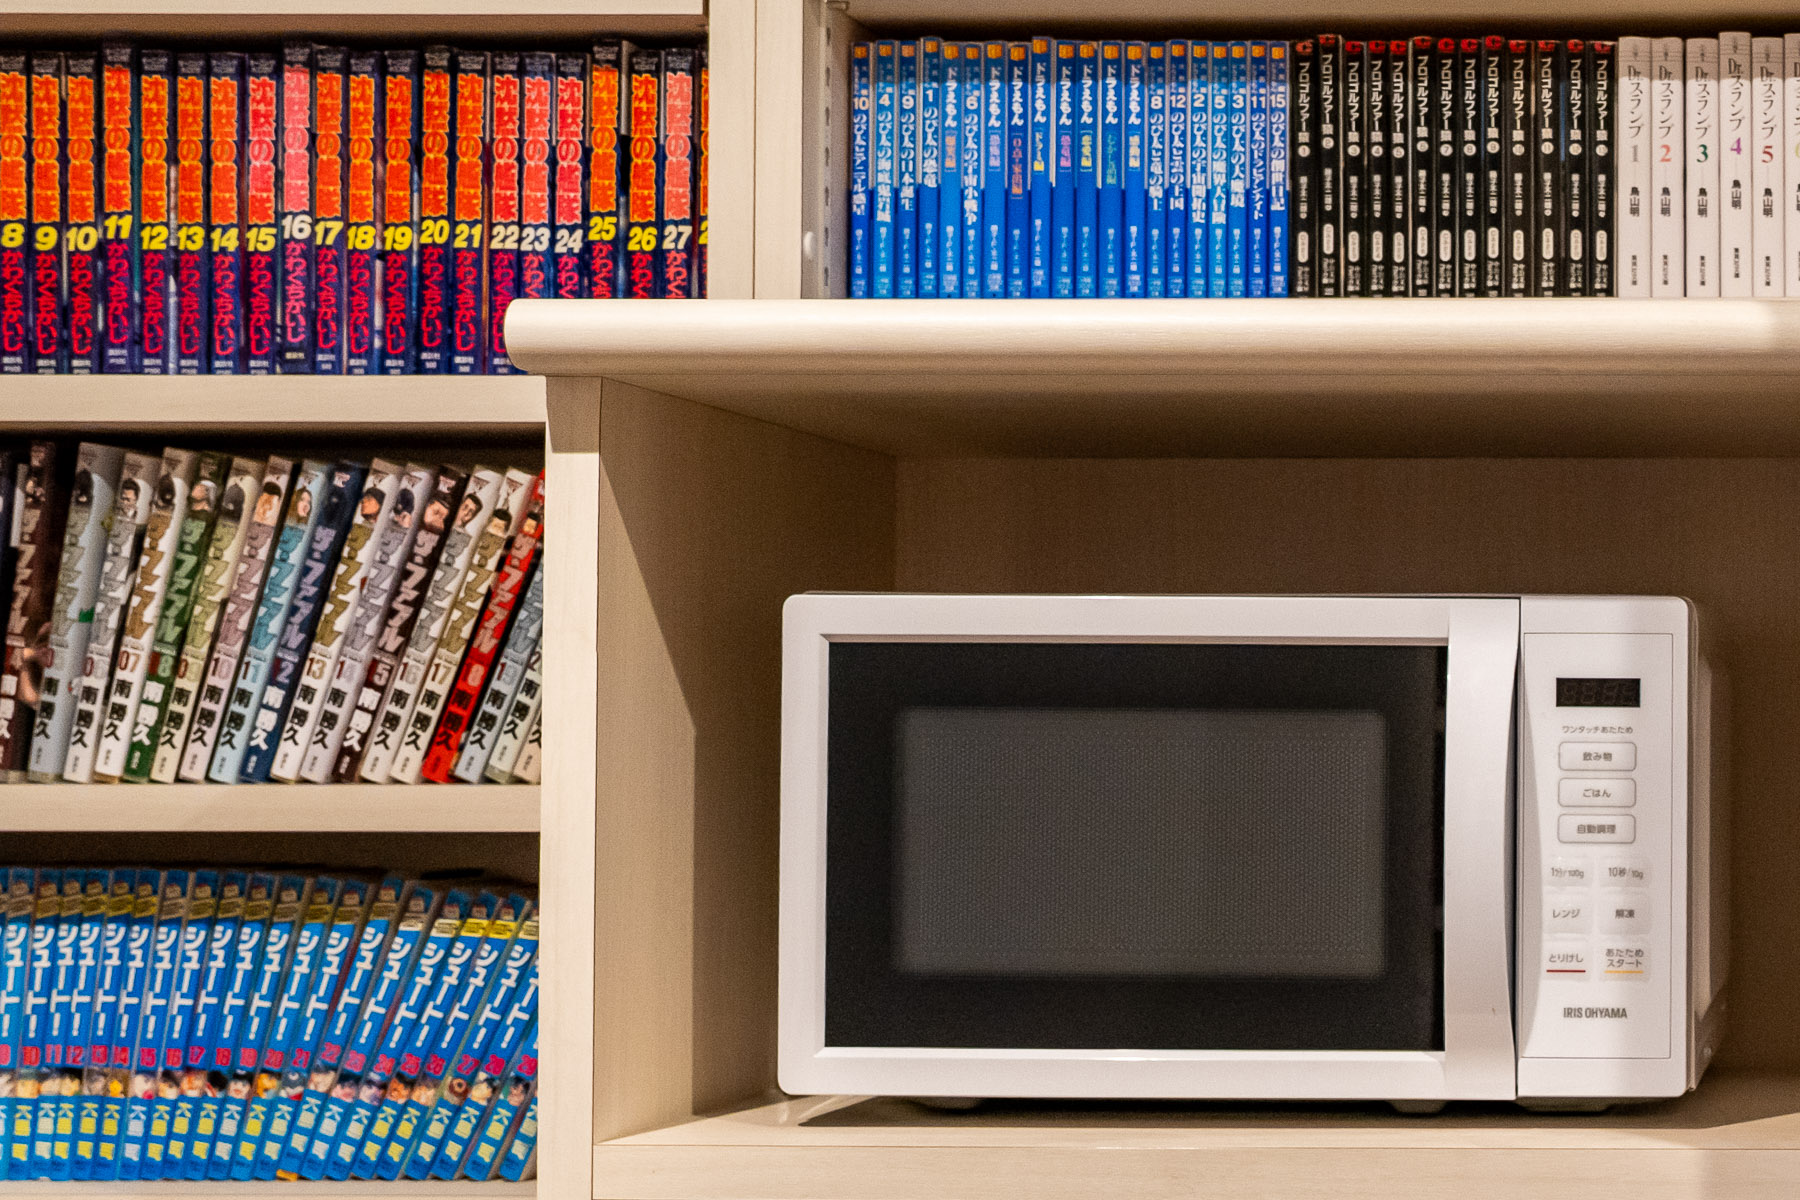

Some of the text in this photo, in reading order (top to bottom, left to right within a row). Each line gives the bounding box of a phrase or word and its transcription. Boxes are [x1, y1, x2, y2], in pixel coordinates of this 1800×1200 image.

[853, 97, 869, 110] 10
[879, 94, 890, 106] 4
[902, 96, 914, 109] 9
[925, 89, 933, 102] 1
[966, 96, 978, 109] 6
[1150, 96, 1162, 109] 8
[1170, 95, 1186, 108] 12
[1193, 94, 1205, 107] 2
[1214, 96, 1226, 109] 5
[1232, 95, 1244, 108] 3
[1251, 95, 1266, 108] 11
[1270, 95, 1286, 108] 15
[1631, 145, 1640, 163] 1
[1659, 144, 1672, 162] 2
[1696, 144, 1708, 163] 3
[1730, 137, 1742, 155] 4
[1761, 145, 1774, 163] 5
[104, 215, 132, 239] 11
[282, 215, 312, 239] 16
[315, 221, 343, 245] 17
[420, 220, 449, 245] 20
[454, 223, 482, 248] 21
[589, 216, 617, 241] 25
[35, 226, 58, 250] 9
[67, 227, 98, 251] 10
[140, 227, 168, 250] 12
[178, 226, 205, 250] 13
[210, 228, 239, 252] 14
[246, 227, 276, 252] 15
[347, 225, 375, 250] 18
[384, 227, 412, 251] 19
[490, 225, 519, 249] 22
[521, 227, 550, 252] 23
[556, 229, 583, 253] 24
[628, 227, 657, 251] 26
[662, 225, 692, 250] 27
[1561, 725, 1634, 735] ワンタッチあたため
[1582, 751, 1613, 762] 飲み物
[1582, 788, 1612, 798] ごはん
[1576, 824, 1617, 835] 自動調理
[1552, 908, 1581, 919] レンジ
[1548, 953, 1584, 963] とりけし
[1605, 948, 1644, 958] あたため
[1606, 958, 1643, 968] スタート
[1563, 1007, 1628, 1019] IRIS OHYAMA
